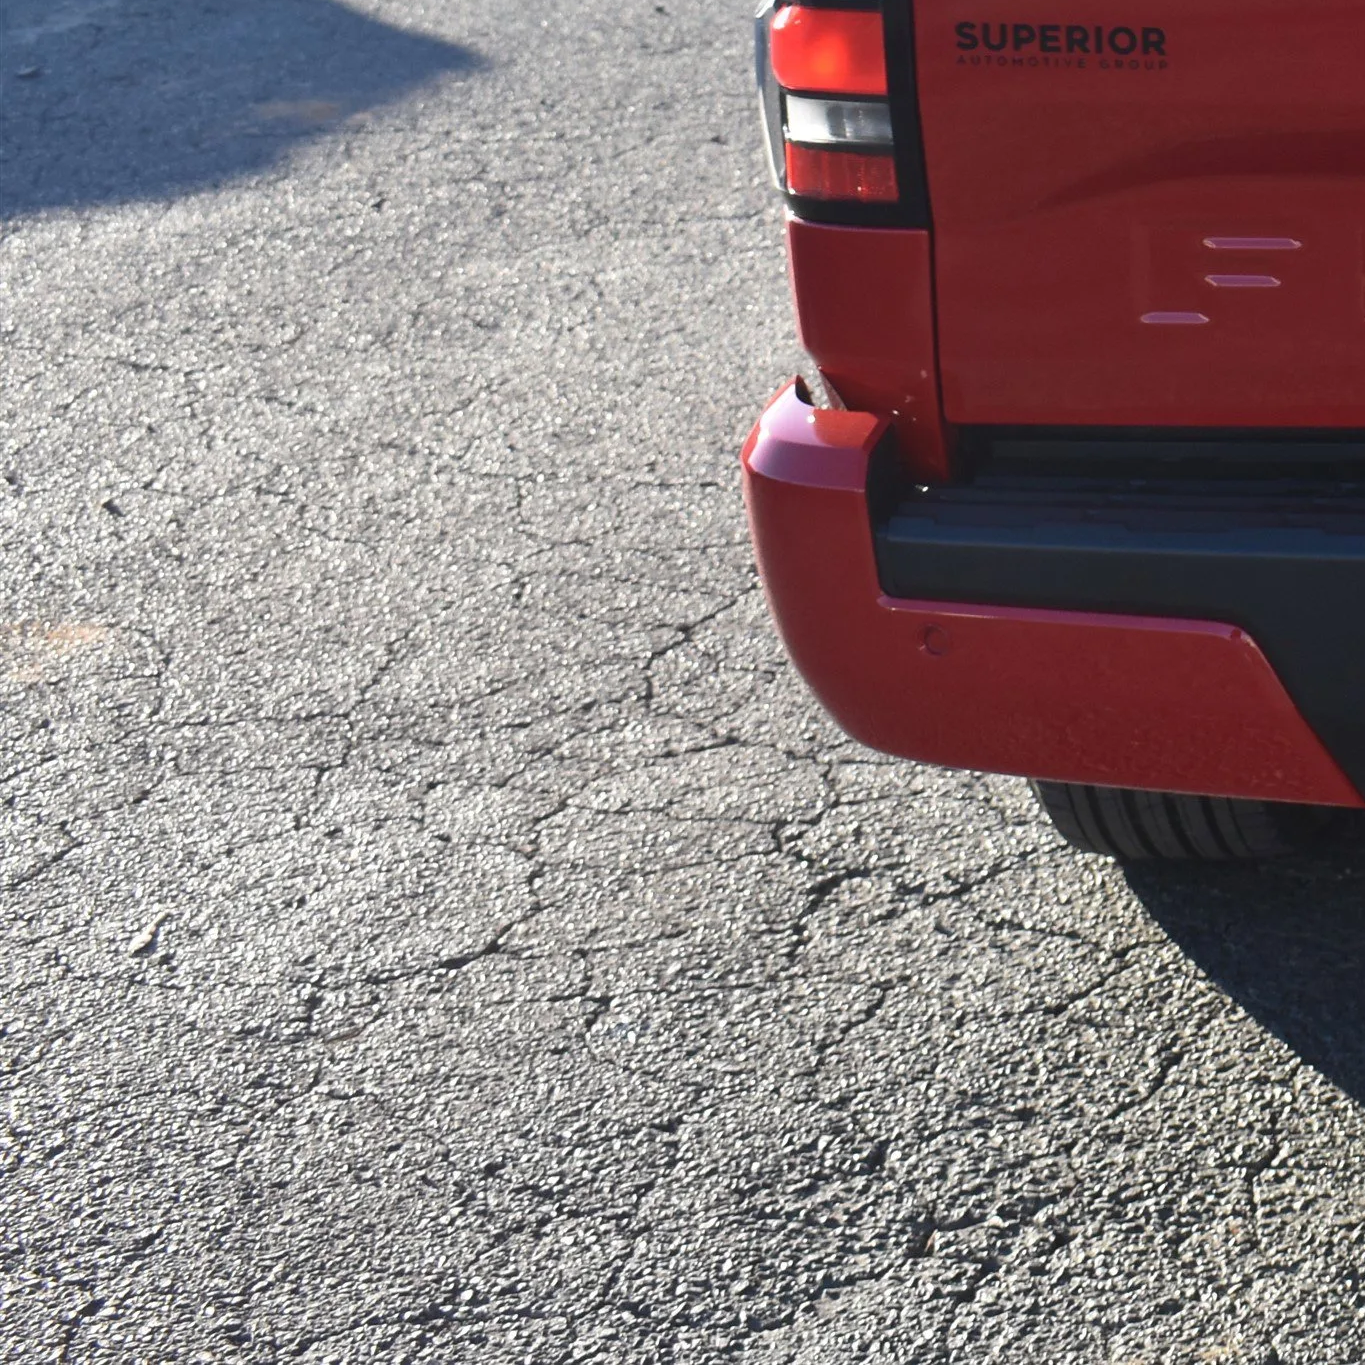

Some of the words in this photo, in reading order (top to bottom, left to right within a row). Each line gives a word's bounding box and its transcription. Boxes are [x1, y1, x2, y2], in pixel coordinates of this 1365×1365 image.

[954, 21, 1167, 57] SUPERIOR
[955, 54, 1087, 70] AUTOMOTIVE
[1100, 58, 1169, 72] GROUP
